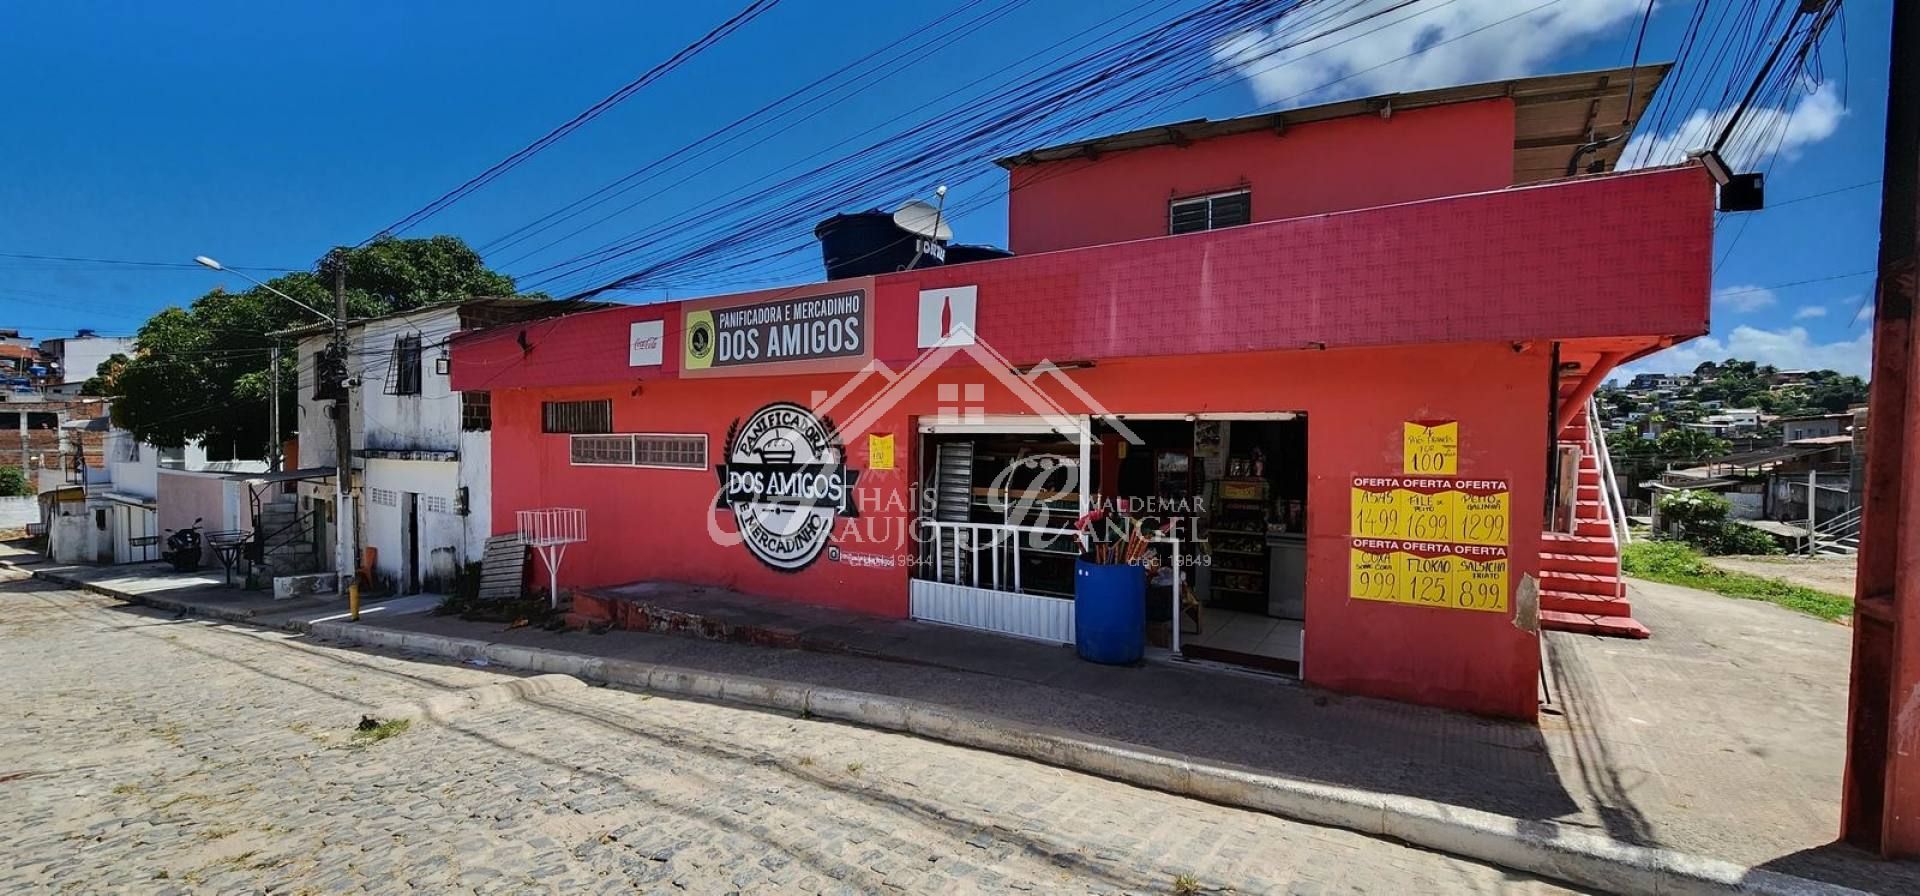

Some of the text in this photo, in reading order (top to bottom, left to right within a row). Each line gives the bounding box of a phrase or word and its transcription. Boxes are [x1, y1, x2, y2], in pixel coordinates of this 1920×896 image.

[720, 295, 859, 329] PANIFICADORA E MERCADINHO
[720, 328, 759, 361] DOS
[767, 316, 859, 358] AMIGOS
[740, 412, 826, 461] PANIFICADORA
[729, 471, 842, 500] DOS AMIGOS
[1354, 478, 1507, 490] OFERTA OFERTA OFERTA
[739, 502, 822, 553] E MERCADINHO
[1353, 539, 1506, 556] OFERTA OFERTA OFERTA
